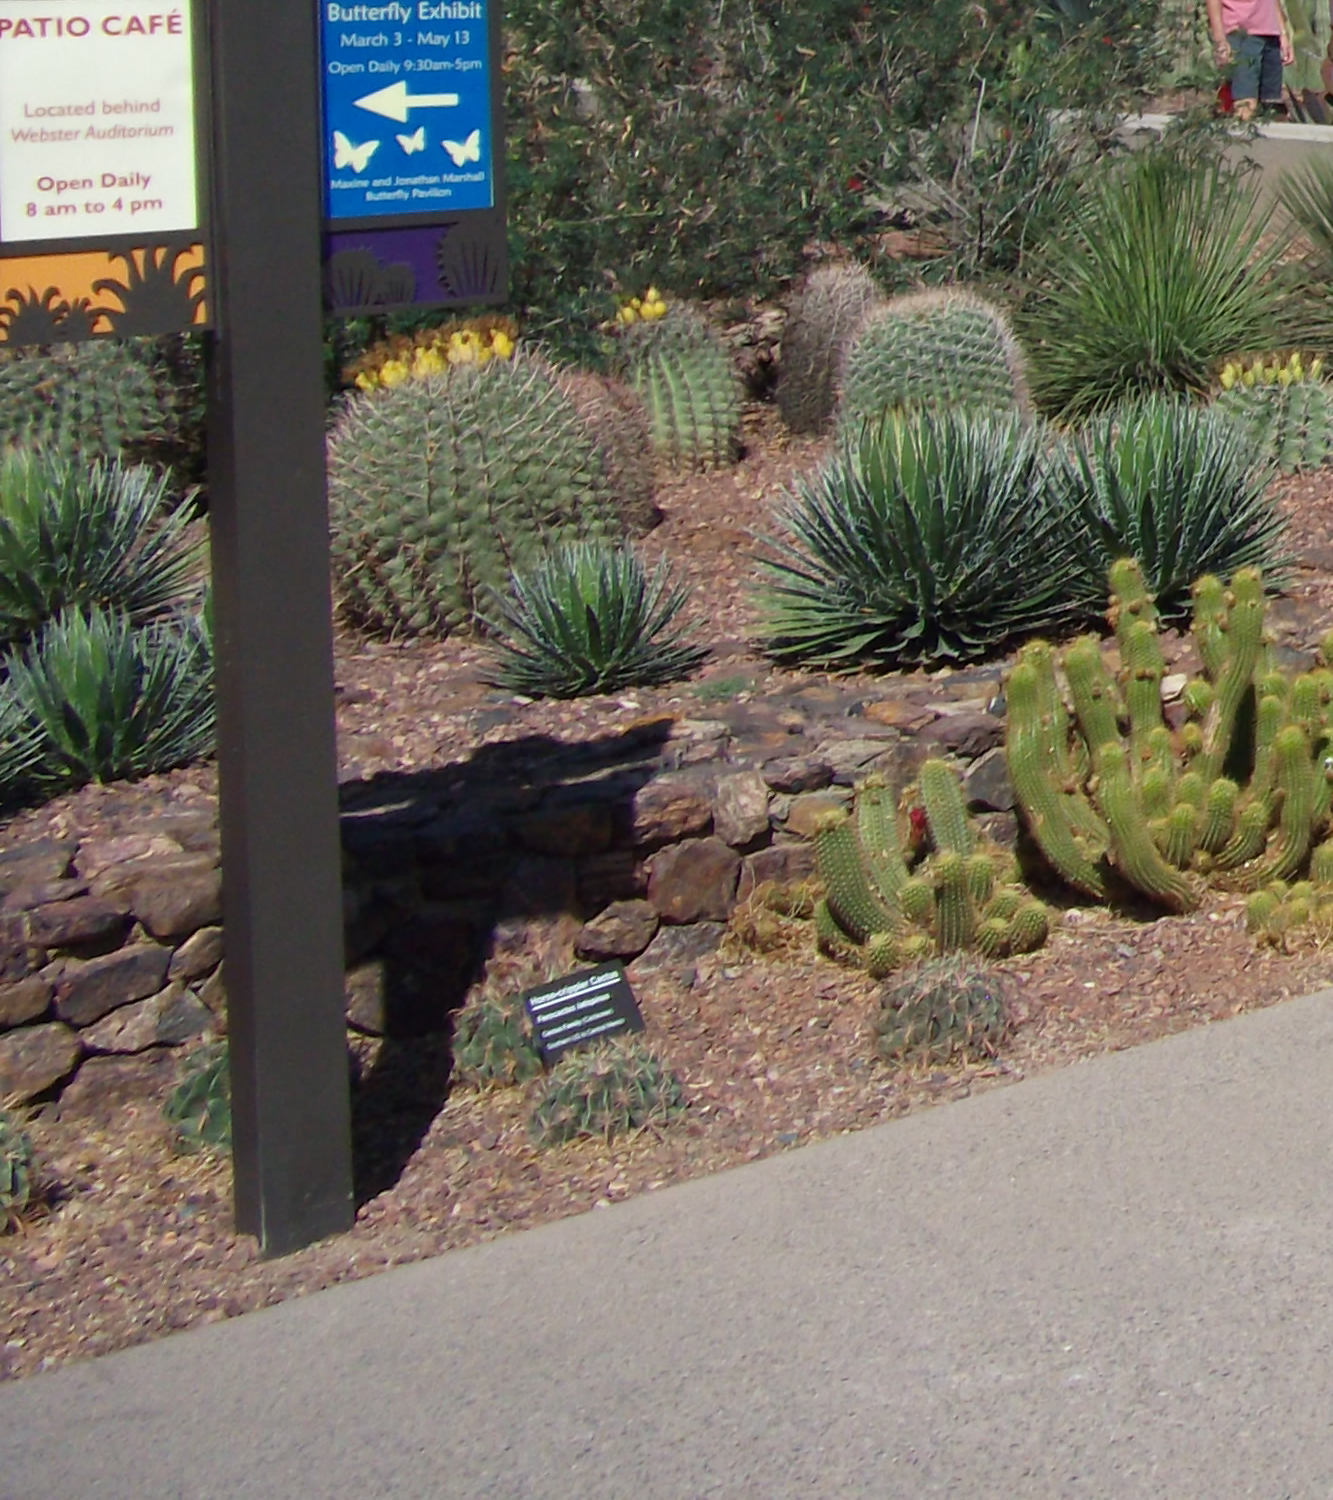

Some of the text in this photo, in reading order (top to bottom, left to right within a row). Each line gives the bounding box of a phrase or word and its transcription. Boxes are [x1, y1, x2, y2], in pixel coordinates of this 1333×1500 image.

[327, 0, 482, 24] Butterfly Exhibit
[0, 9, 183, 39] PATIO CAFÉ
[340, 32, 389, 47] March
[393, 31, 403, 47] 3
[416, 31, 450, 48] May
[454, 30, 470, 45] 13
[328, 57, 483, 76] Open Daily 9:30am-5pm
[23, 98, 161, 119] Located behind
[11, 124, 175, 143] Webster Auditorium
[36, 171, 151, 194] Open Daily
[26, 197, 164, 218] 8 am to 4 pm
